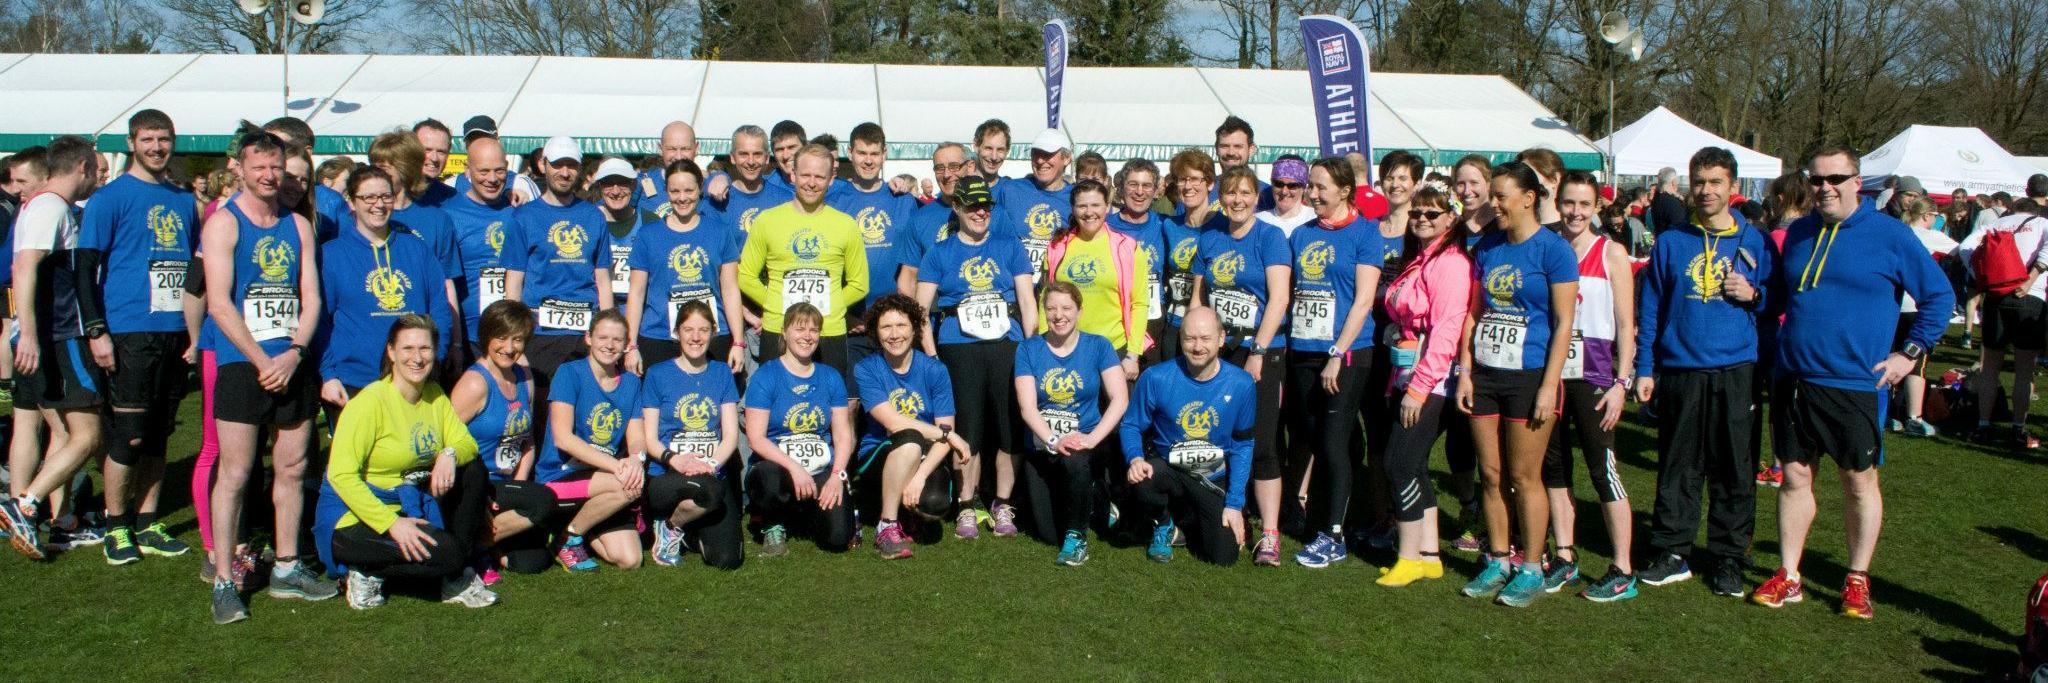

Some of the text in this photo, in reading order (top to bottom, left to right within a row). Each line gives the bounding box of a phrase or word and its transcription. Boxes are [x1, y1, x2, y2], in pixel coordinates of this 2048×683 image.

[1324, 54, 1344, 63] ROYAL
[1325, 60, 1346, 69] NAVY
[1325, 84, 1358, 155] ATHLE
[788, 279, 825, 294] 2475
[253, 300, 294, 319] 1544
[965, 303, 1000, 321] F441
[1214, 297, 1250, 319] F458
[546, 309, 586, 327] 1738
[1480, 324, 1518, 344] F418
[786, 443, 824, 458] F396
[1176, 449, 1217, 465] 1562
